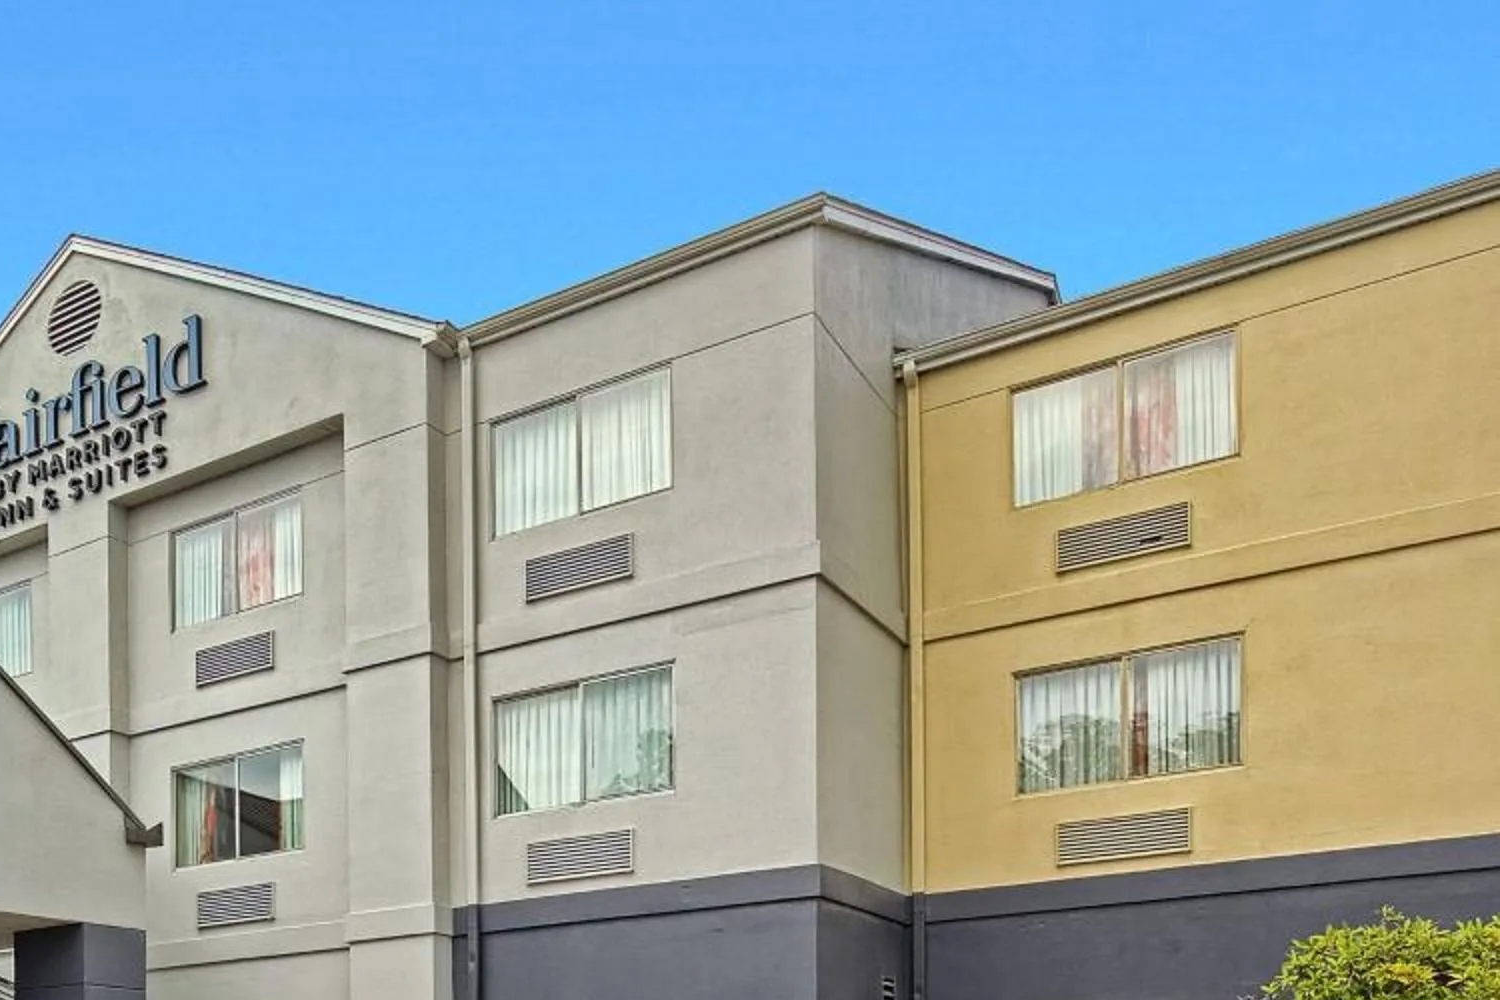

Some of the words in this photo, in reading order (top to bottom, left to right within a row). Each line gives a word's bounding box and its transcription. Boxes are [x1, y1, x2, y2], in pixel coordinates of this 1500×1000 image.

[28, 410, 168, 486] MARRIOTT
[42, 487, 60, 511] &
[68, 444, 169, 501] SUITES
